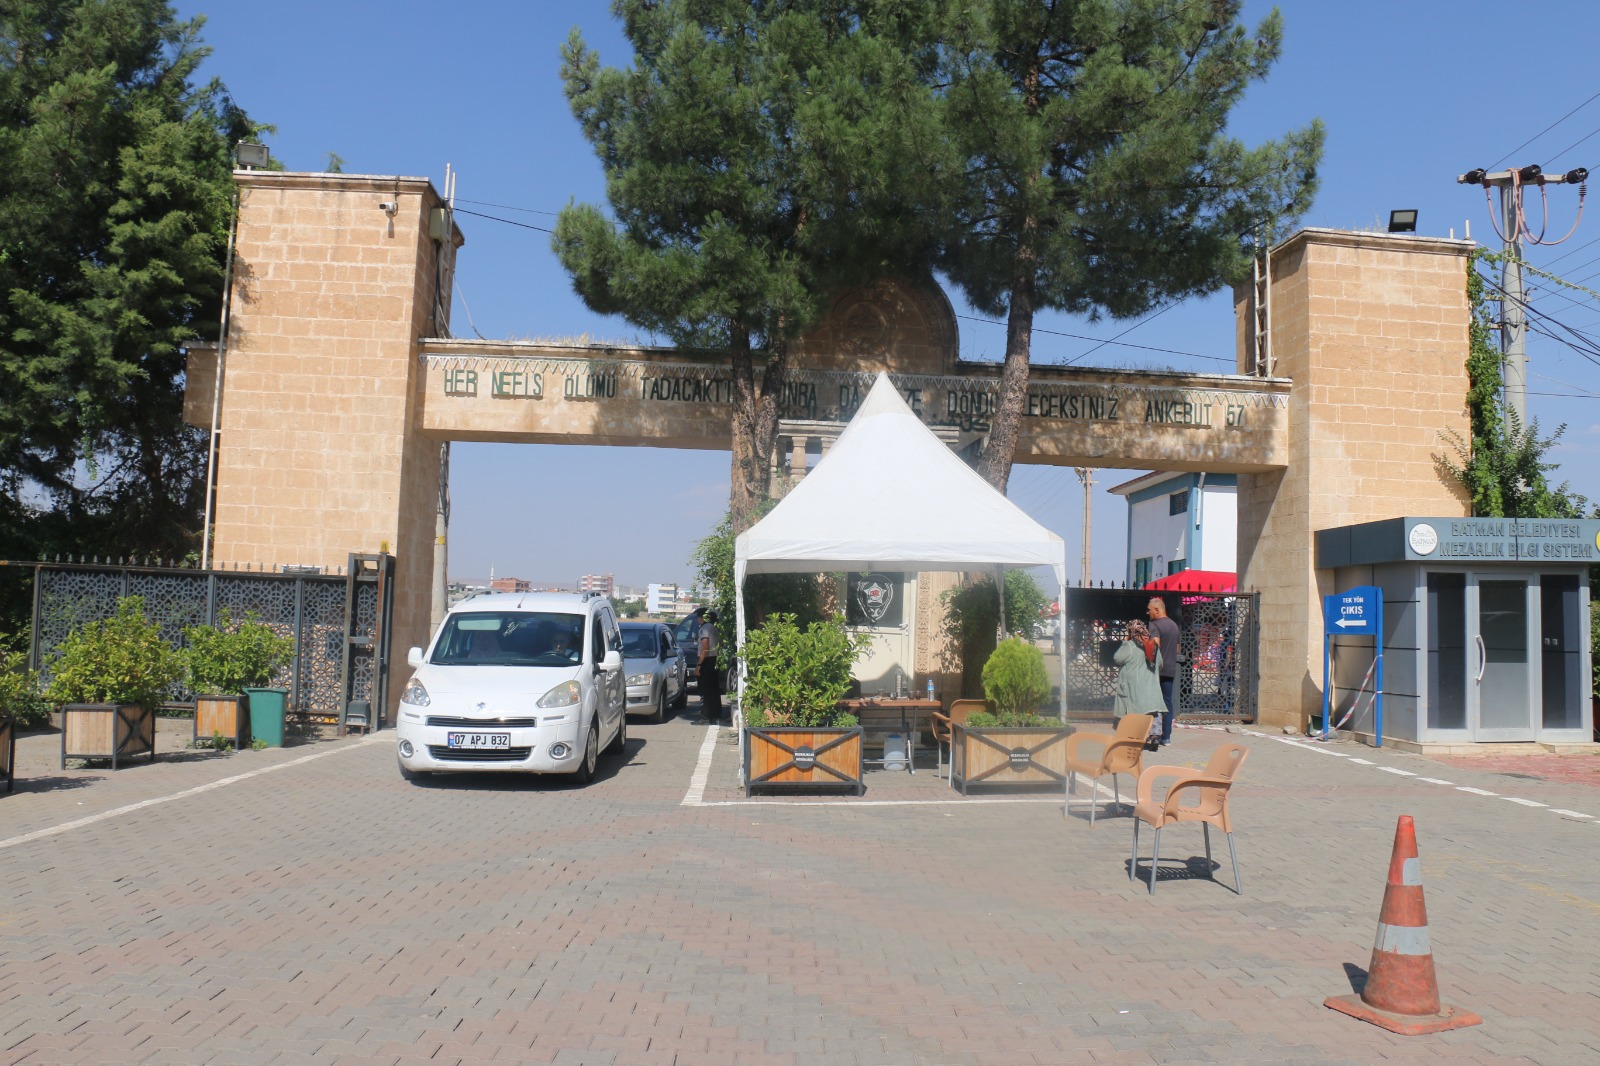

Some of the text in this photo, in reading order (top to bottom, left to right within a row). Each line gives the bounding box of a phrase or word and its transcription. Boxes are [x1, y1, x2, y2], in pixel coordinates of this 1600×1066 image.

[444, 369, 477, 393] HER
[491, 371, 543, 396] NEFİS
[564, 374, 616, 398] ÖLÜMÜ
[1145, 399, 1212, 427] ANKEBUT
[1226, 403, 1245, 427] 57
[1451, 521, 1504, 537] BATMAN
[1508, 522, 1581, 539] BELEDİYESİ
[1439, 541, 1504, 557] MEZARLIK
[1353, 595, 1364, 604] YÖN
[1340, 605, 1363, 618] ÇIKIŞ
[454, 734, 508, 746] 07 APJ 832
